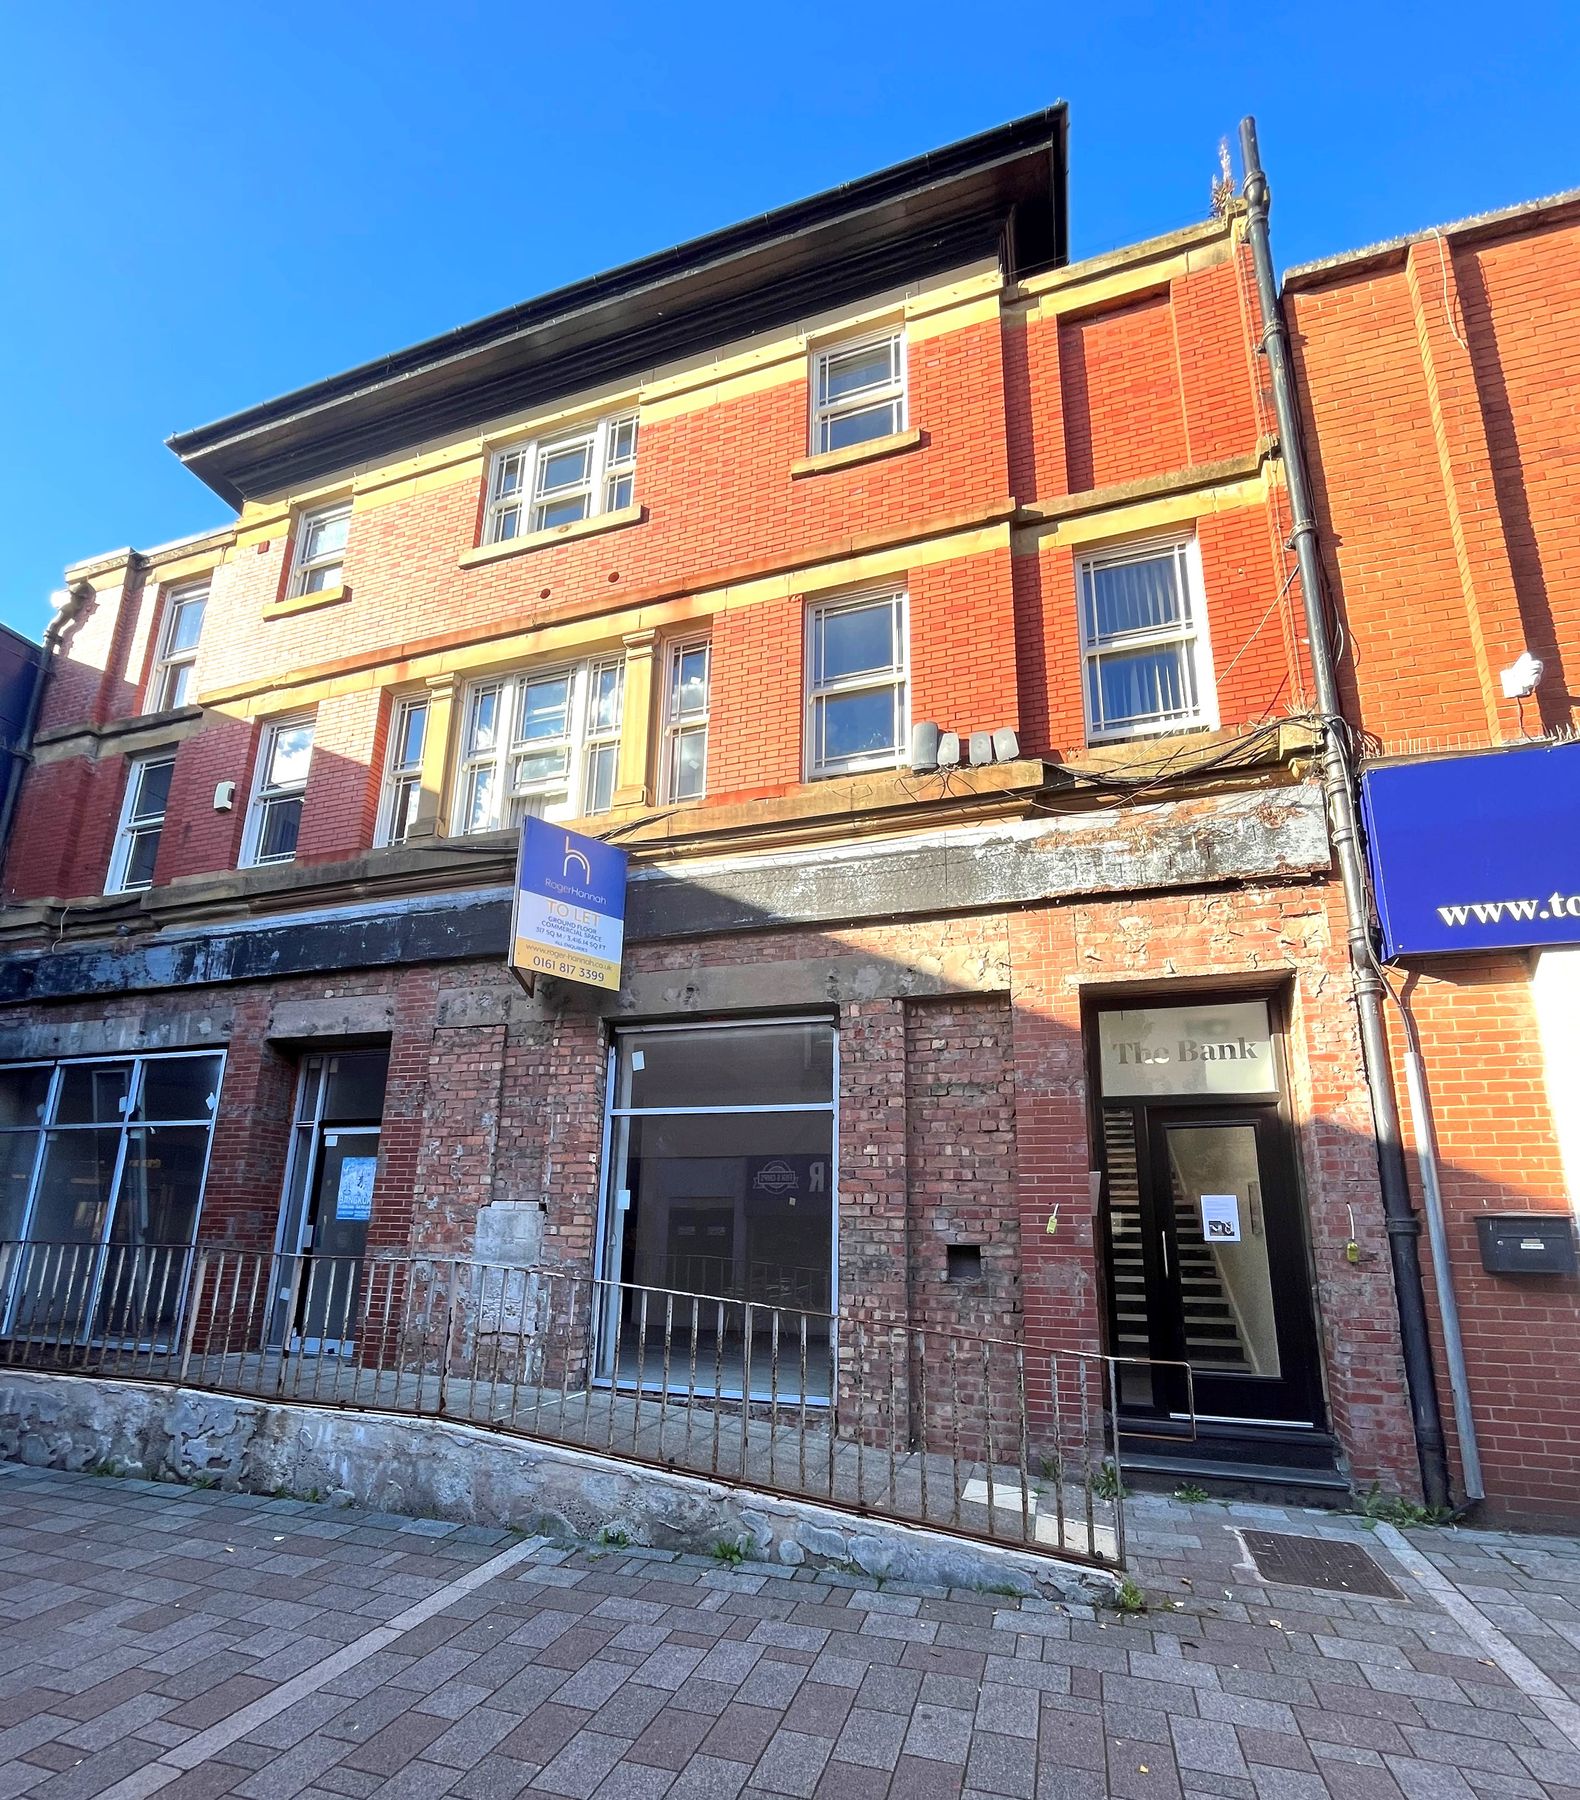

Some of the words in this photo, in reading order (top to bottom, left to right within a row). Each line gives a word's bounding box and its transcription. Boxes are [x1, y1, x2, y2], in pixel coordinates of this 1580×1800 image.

[545, 878, 608, 905] RogerHannah
[546, 900, 569, 917] TO
[574, 907, 601, 927] LET
[548, 916, 576, 929] GROUND
[577, 924, 597, 935] FLOOR
[541, 920, 583, 936] COMMERCIAL
[584, 932, 603, 943] SPACE
[546, 929, 555, 939] SQ
[589, 941, 598, 950] SQ
[533, 955, 556, 970] 0161
[559, 962, 576, 975] 817
[579, 967, 605, 982] 3399
[1112, 1041, 1170, 1065] The
[1177, 1037, 1258, 1062] Bank
